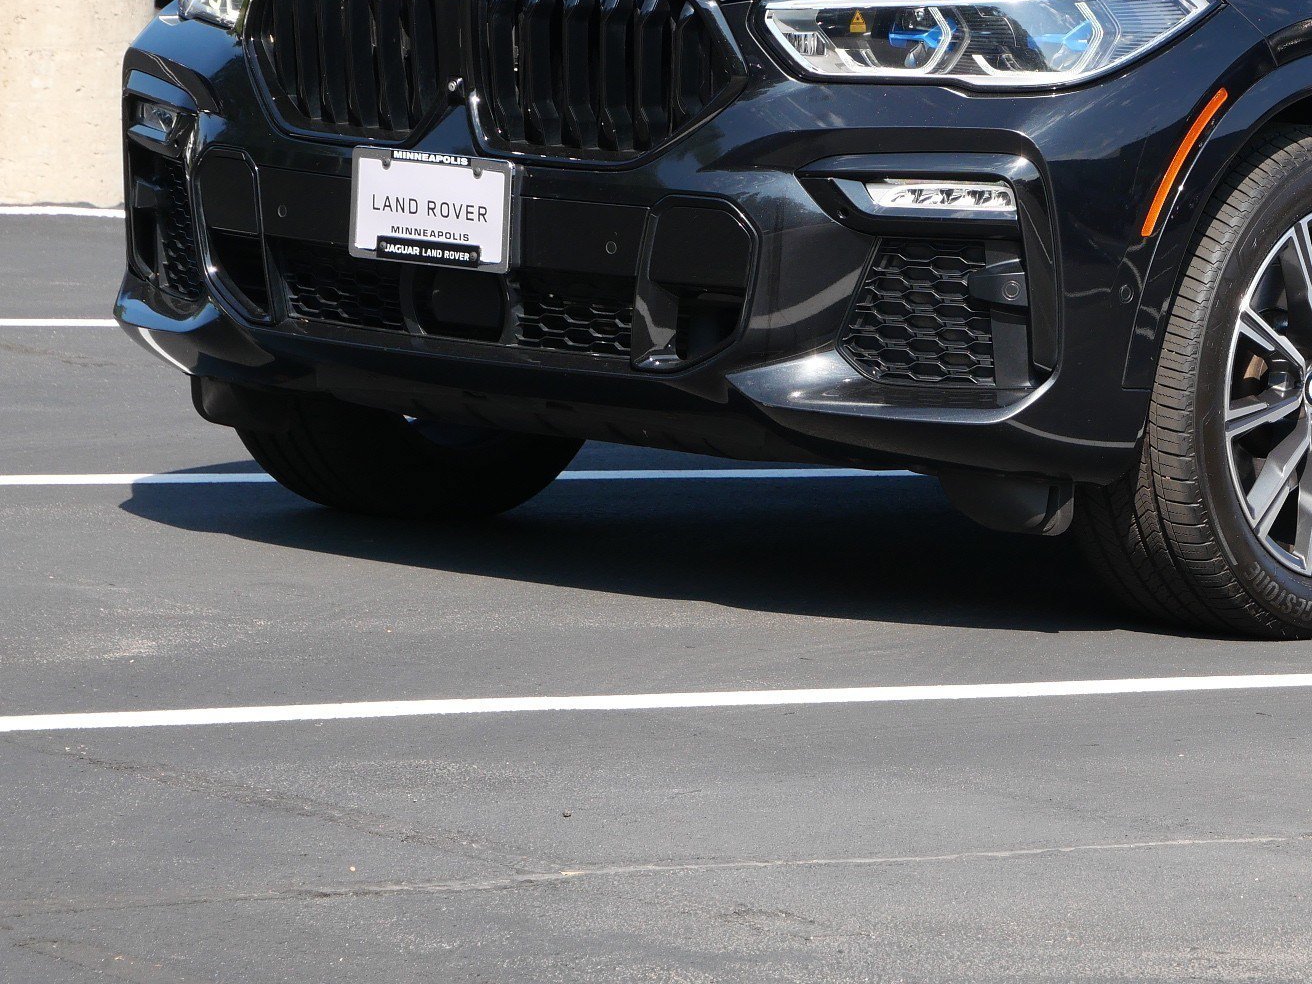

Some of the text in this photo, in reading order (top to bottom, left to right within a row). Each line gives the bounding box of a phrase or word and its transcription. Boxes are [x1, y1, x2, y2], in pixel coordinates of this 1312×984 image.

[393, 150, 468, 165] MINNEAPOLIS
[372, 193, 488, 223] LAND ROVER
[391, 225, 469, 241] MINNEAPOLIS
[384, 243, 470, 261] JAGUAR LAND ROVER
